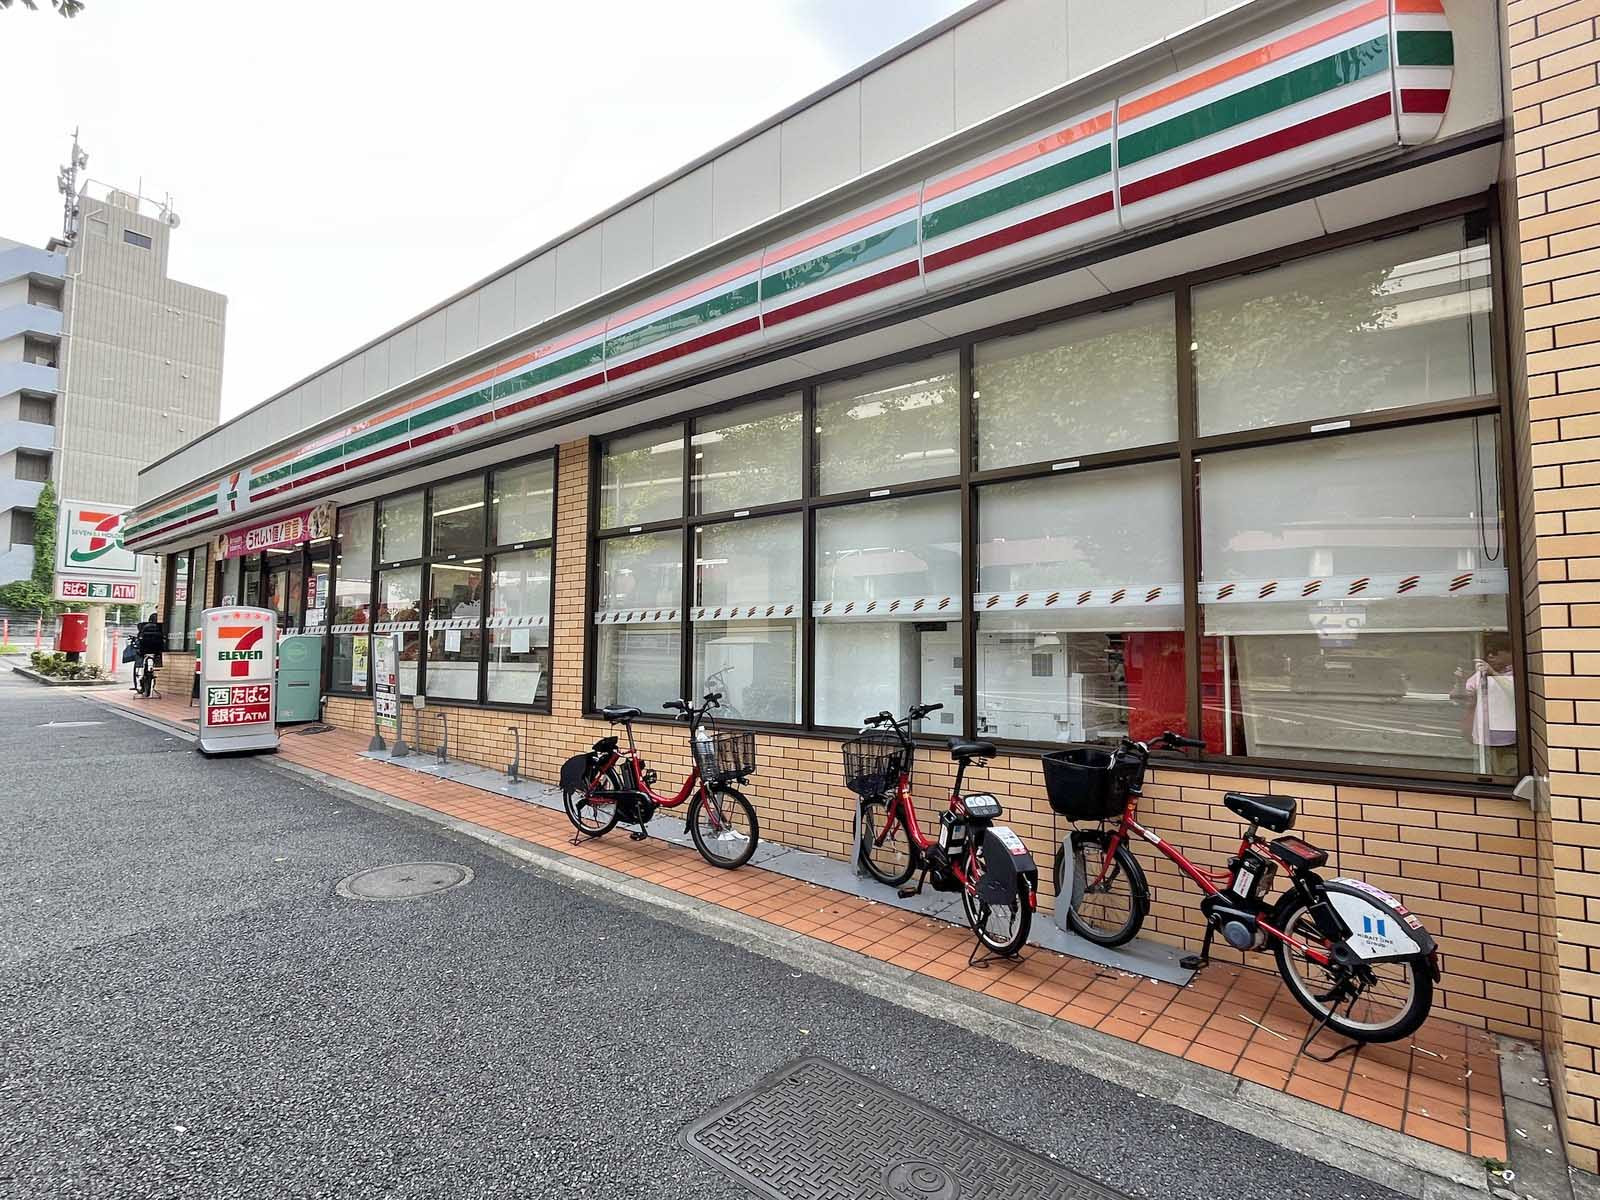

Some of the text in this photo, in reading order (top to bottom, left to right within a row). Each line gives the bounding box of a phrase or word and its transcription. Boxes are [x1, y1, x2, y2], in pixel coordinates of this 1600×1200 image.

[63, 582, 135, 598] たばこ 酒 ATM
[218, 626, 263, 676] 7
[209, 686, 269, 705] 酒 たばこ
